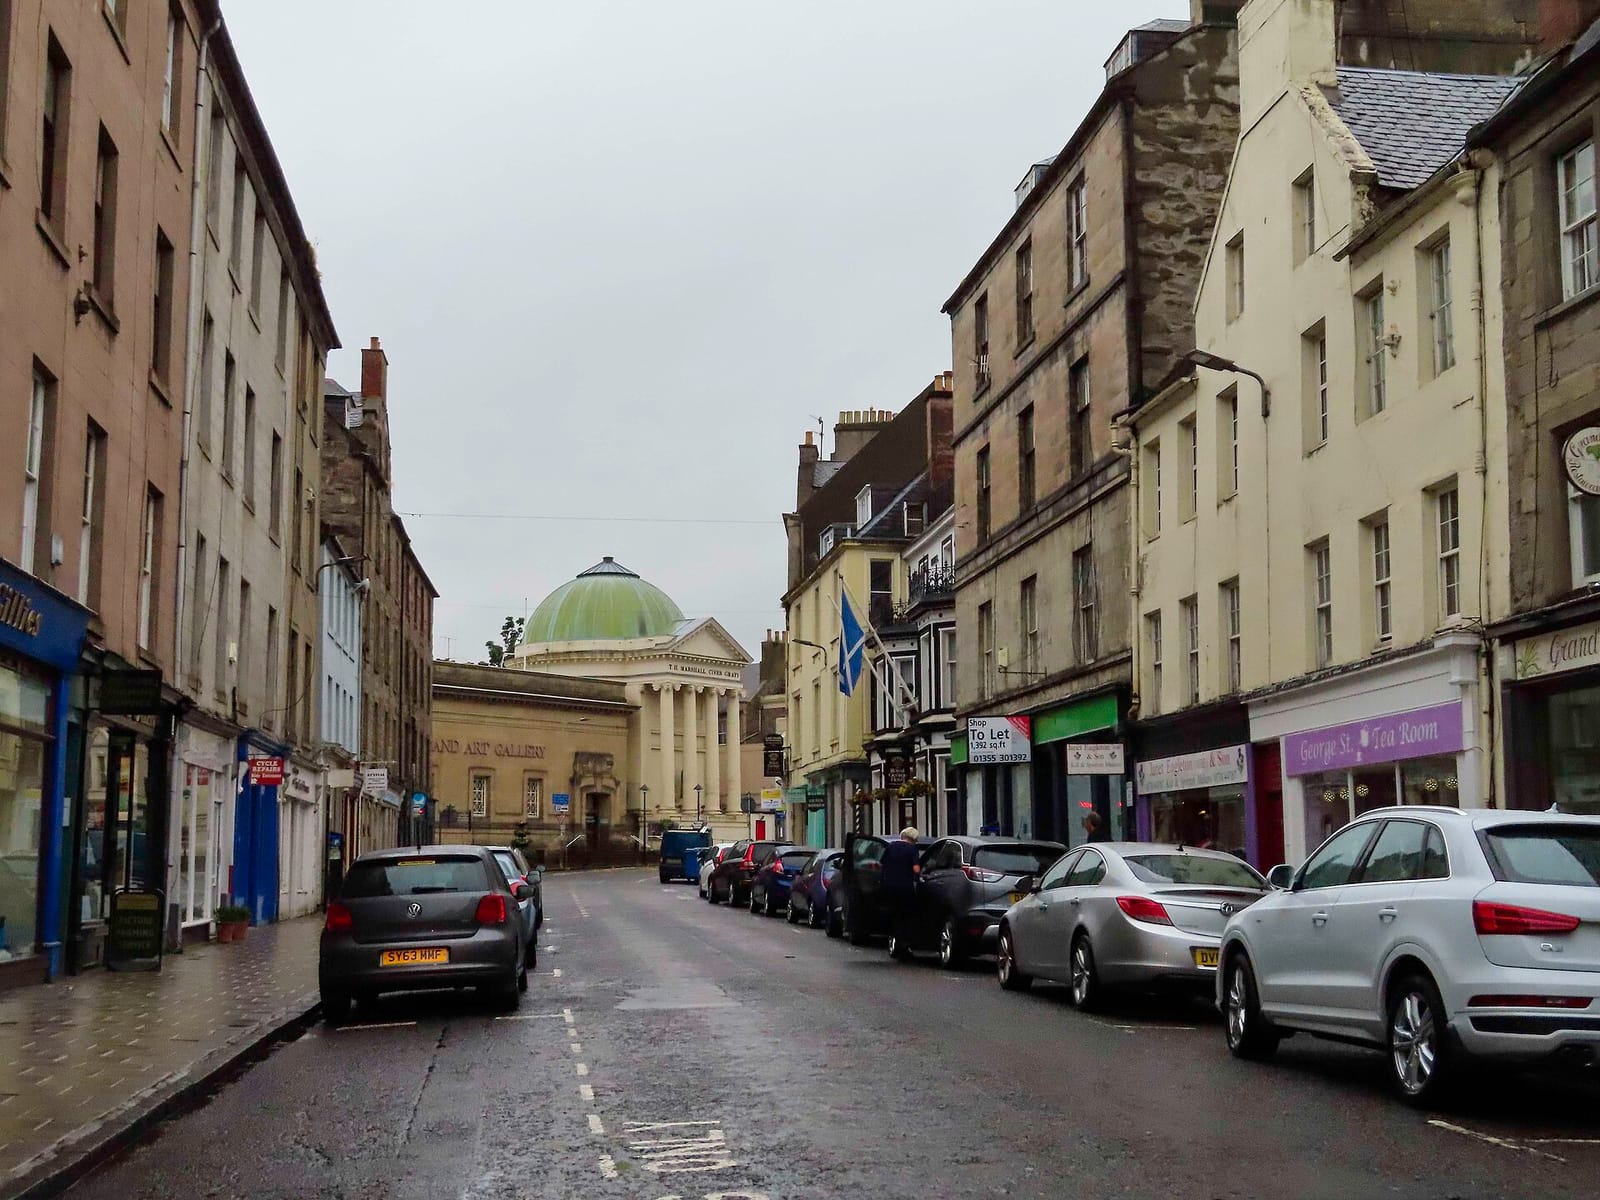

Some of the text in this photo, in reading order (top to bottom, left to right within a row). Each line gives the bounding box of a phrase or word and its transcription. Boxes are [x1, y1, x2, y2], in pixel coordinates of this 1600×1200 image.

[969, 719, 987, 728] Shop
[969, 728, 1010, 741] To Let
[432, 739, 546, 759] AND ART GALLERY
[970, 741, 987, 750] 1,392
[1300, 720, 1439, 766] George St. Tea Room
[973, 754, 997, 763] 01355
[999, 753, 1027, 762] 301392
[387, 950, 418, 962] SY63
